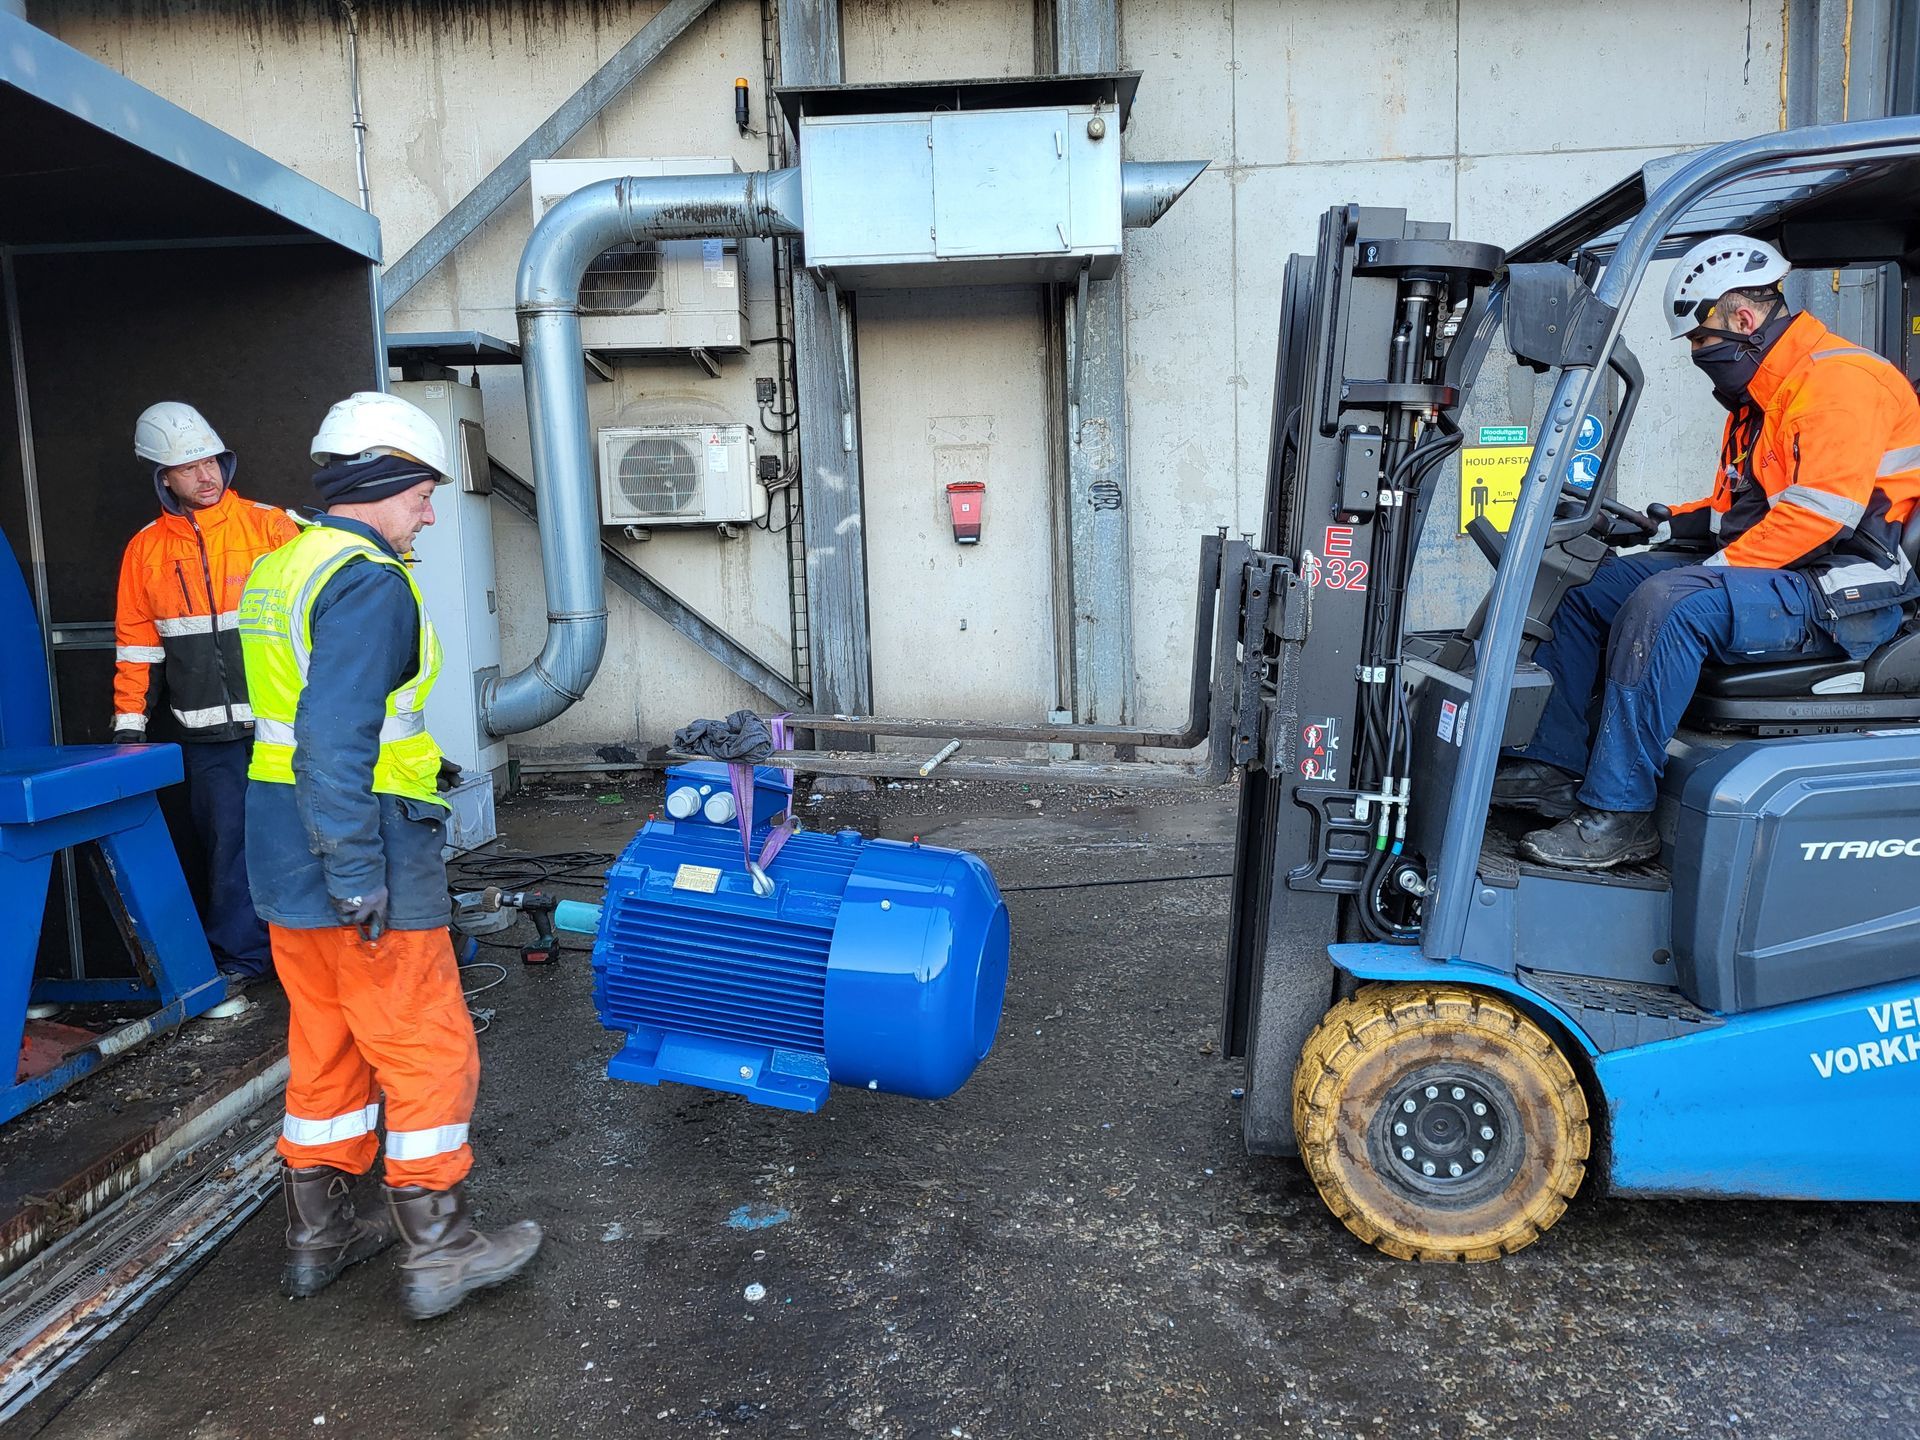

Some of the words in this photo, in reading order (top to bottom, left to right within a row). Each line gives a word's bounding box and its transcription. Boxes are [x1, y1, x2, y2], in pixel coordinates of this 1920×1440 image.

[1465, 457, 1495, 467] HOUD
[1323, 525, 1354, 558] E
[1801, 704, 1874, 716] GRAMMER
[1867, 996, 1920, 1033] VE
